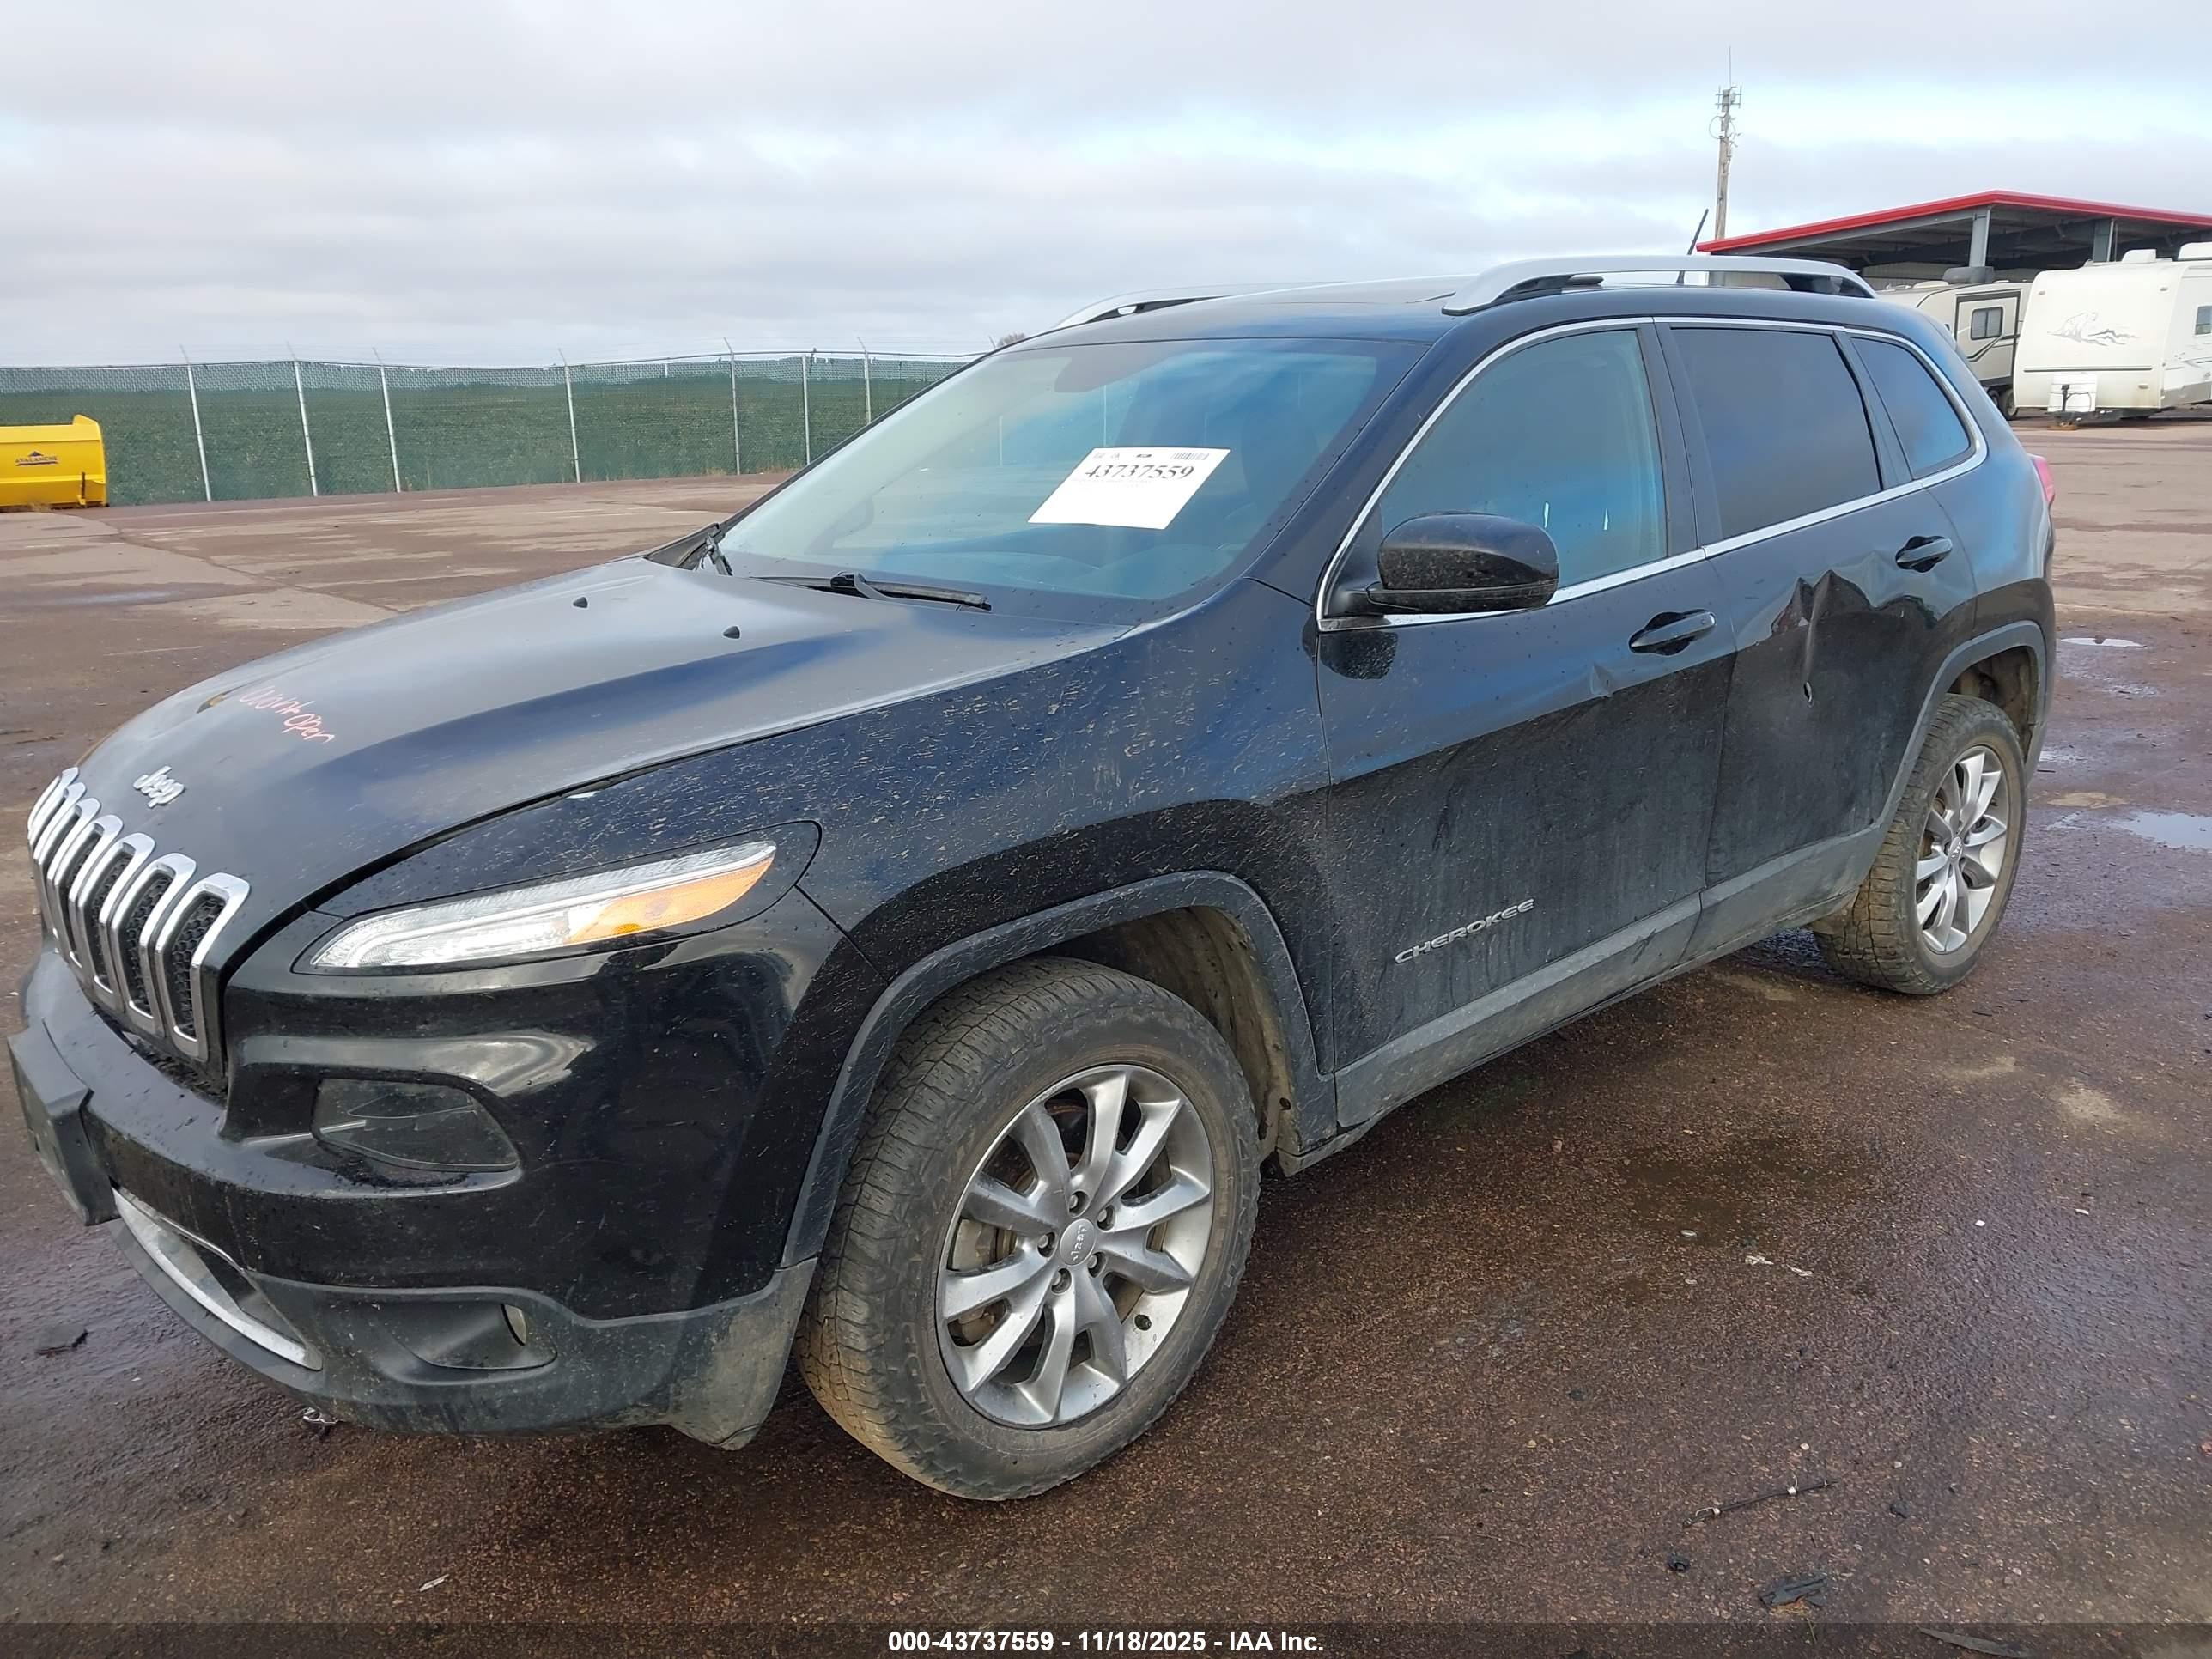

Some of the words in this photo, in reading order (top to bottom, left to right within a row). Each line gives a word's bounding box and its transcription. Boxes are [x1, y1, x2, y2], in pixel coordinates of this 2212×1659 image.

[1085, 465, 1194, 480] 43737559
[132, 765, 185, 808] Jeep
[1395, 898, 1534, 963] CHEROKEE
